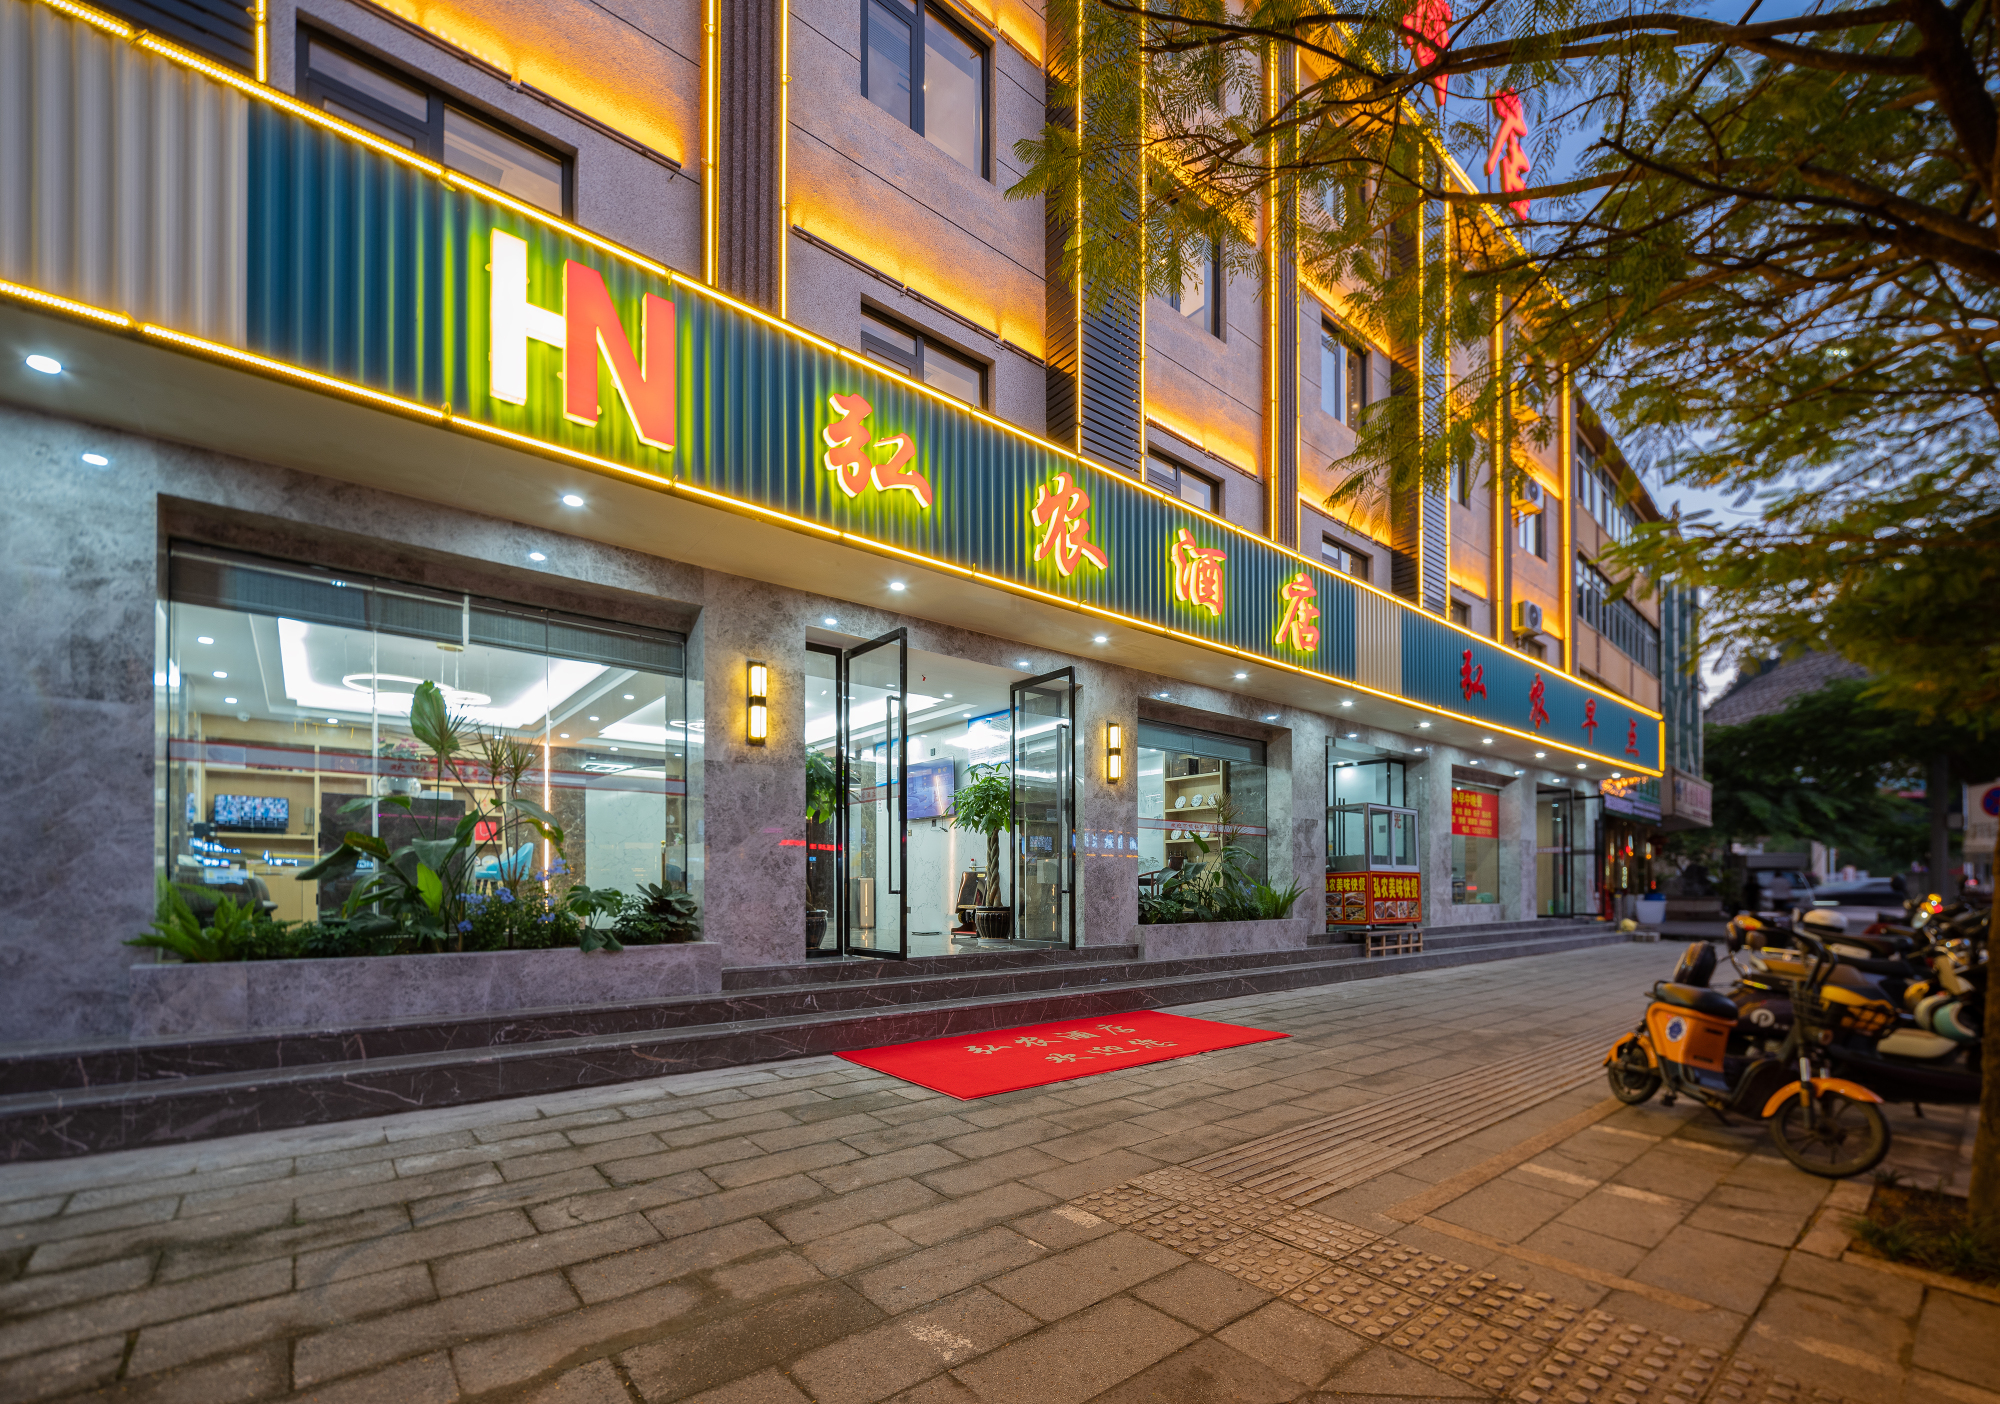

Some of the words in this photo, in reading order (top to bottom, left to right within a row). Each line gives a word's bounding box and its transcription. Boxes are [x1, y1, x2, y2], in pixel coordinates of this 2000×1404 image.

[489, 227, 675, 452] HN
[822, 393, 1321, 653] 弘农酒店
[1373, 877, 1418, 899] 弘农美味快餐
[963, 1023, 1137, 1055] 弘农酒店
[1044, 1038, 1179, 1064] 欢迎您
